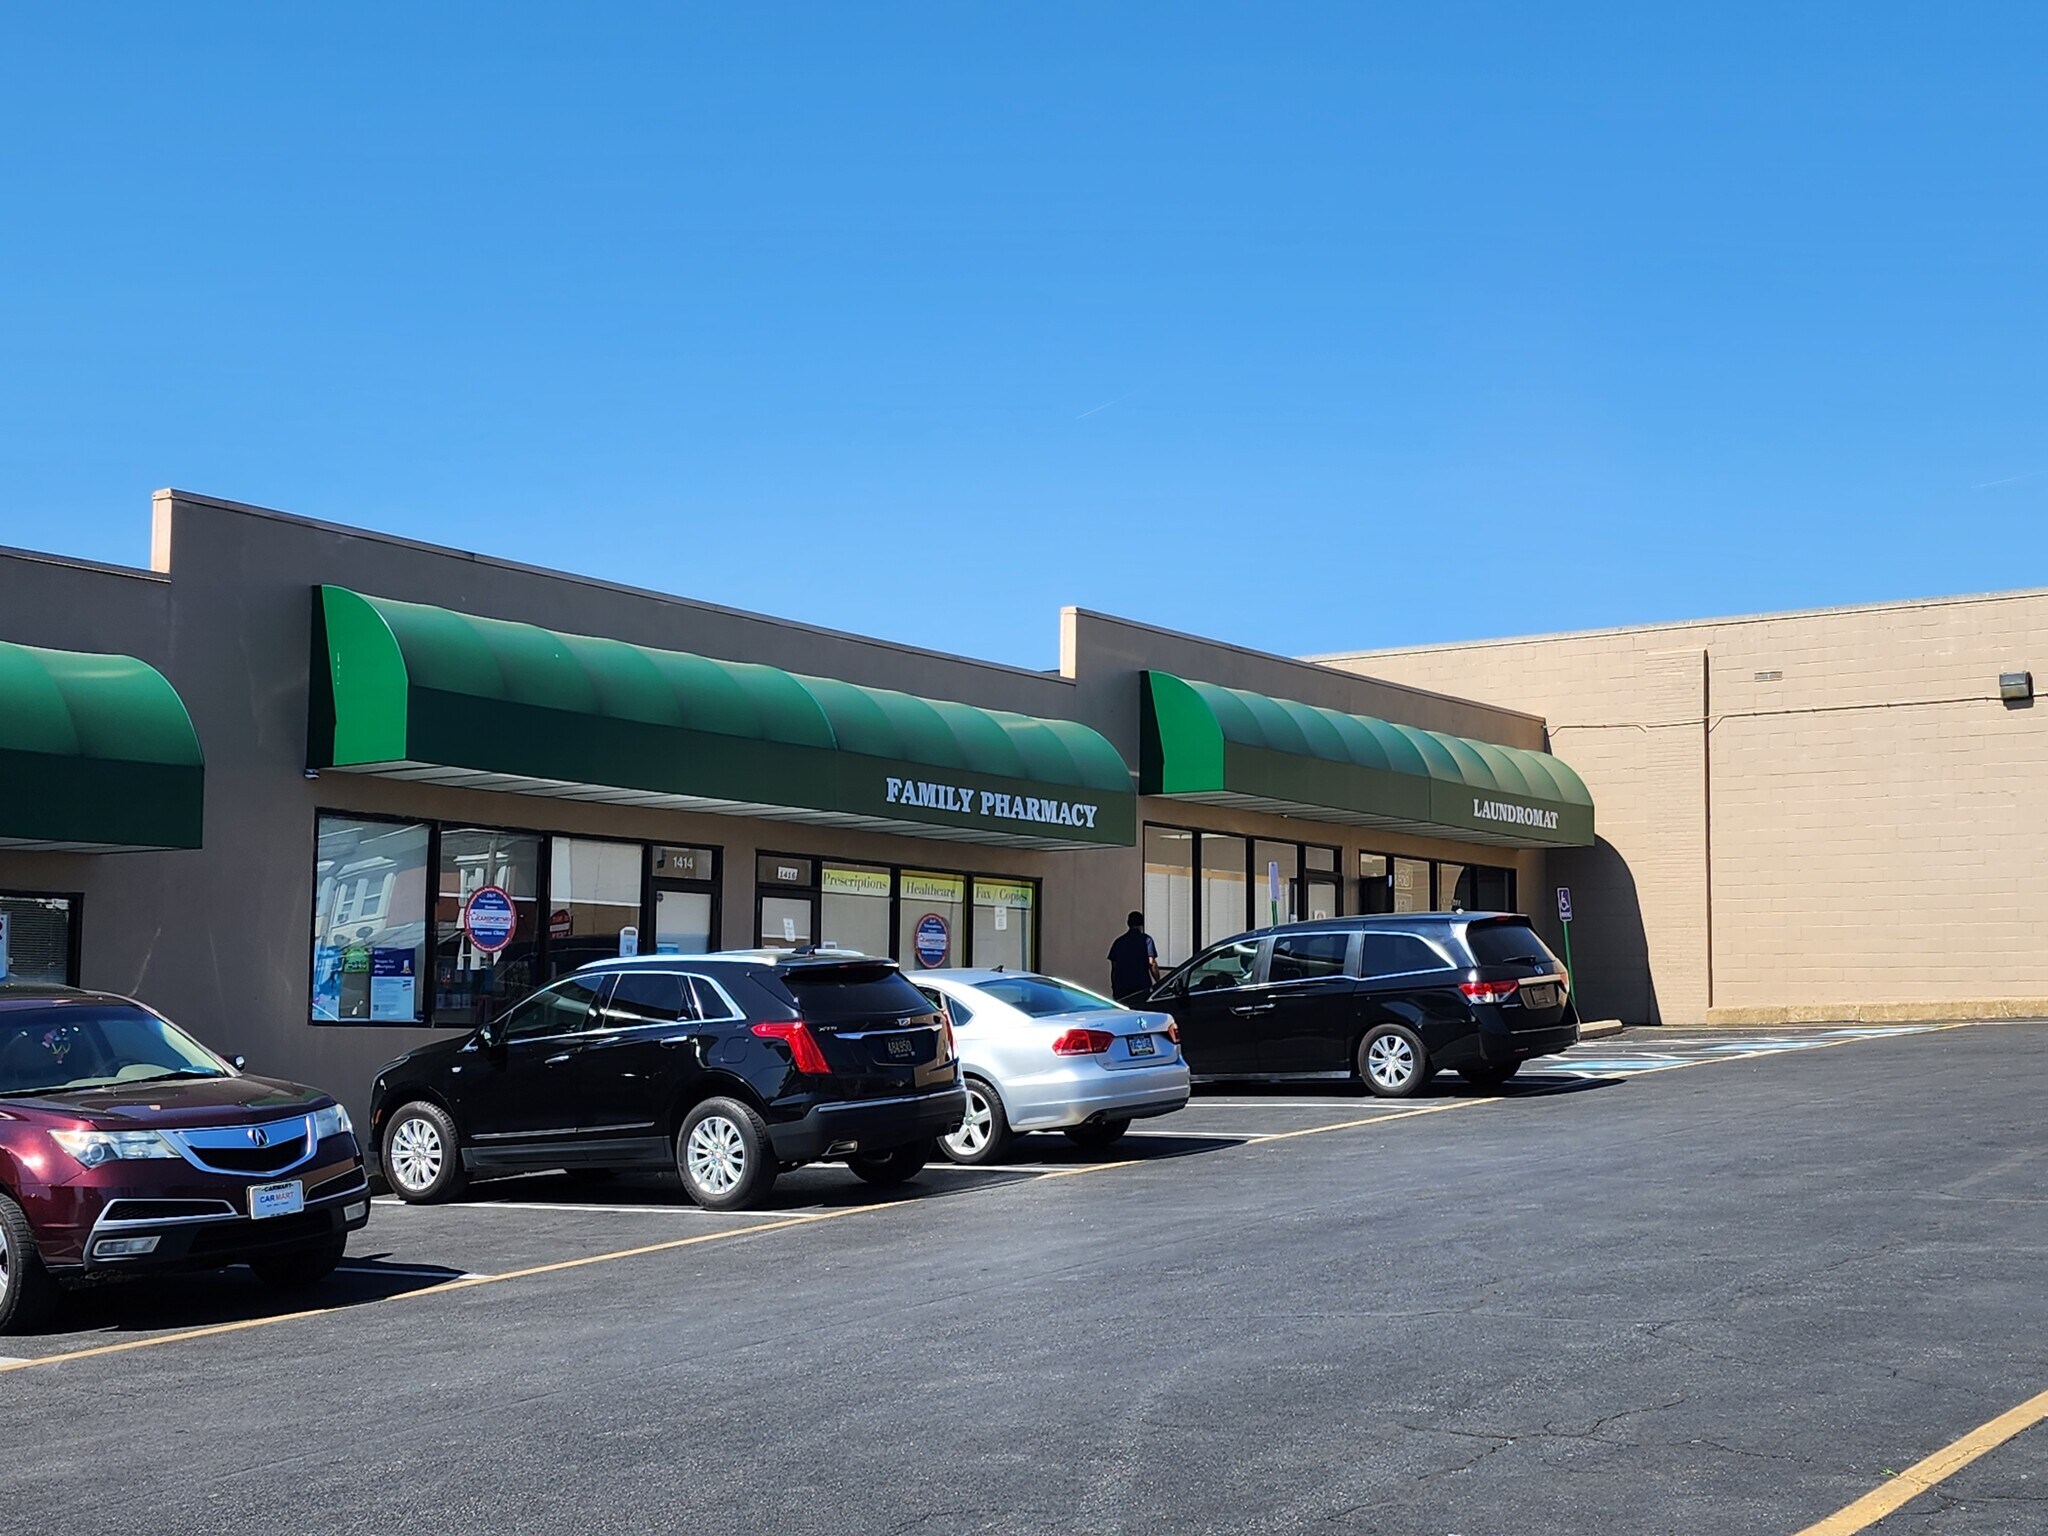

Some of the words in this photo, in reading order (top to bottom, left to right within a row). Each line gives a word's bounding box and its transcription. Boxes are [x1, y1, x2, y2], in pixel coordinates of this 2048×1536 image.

[886, 777, 974, 813] FAMILY
[980, 791, 1098, 828] PHARMACY
[1473, 798, 1559, 829] LAUNDROMAT
[673, 856, 693, 869] 1414
[779, 870, 796, 879] 1416
[823, 871, 887, 891] Prescriptions
[905, 881, 956, 898] Healthcare
[975, 886, 991, 899] Fax
[999, 888, 1028, 904] Copies
